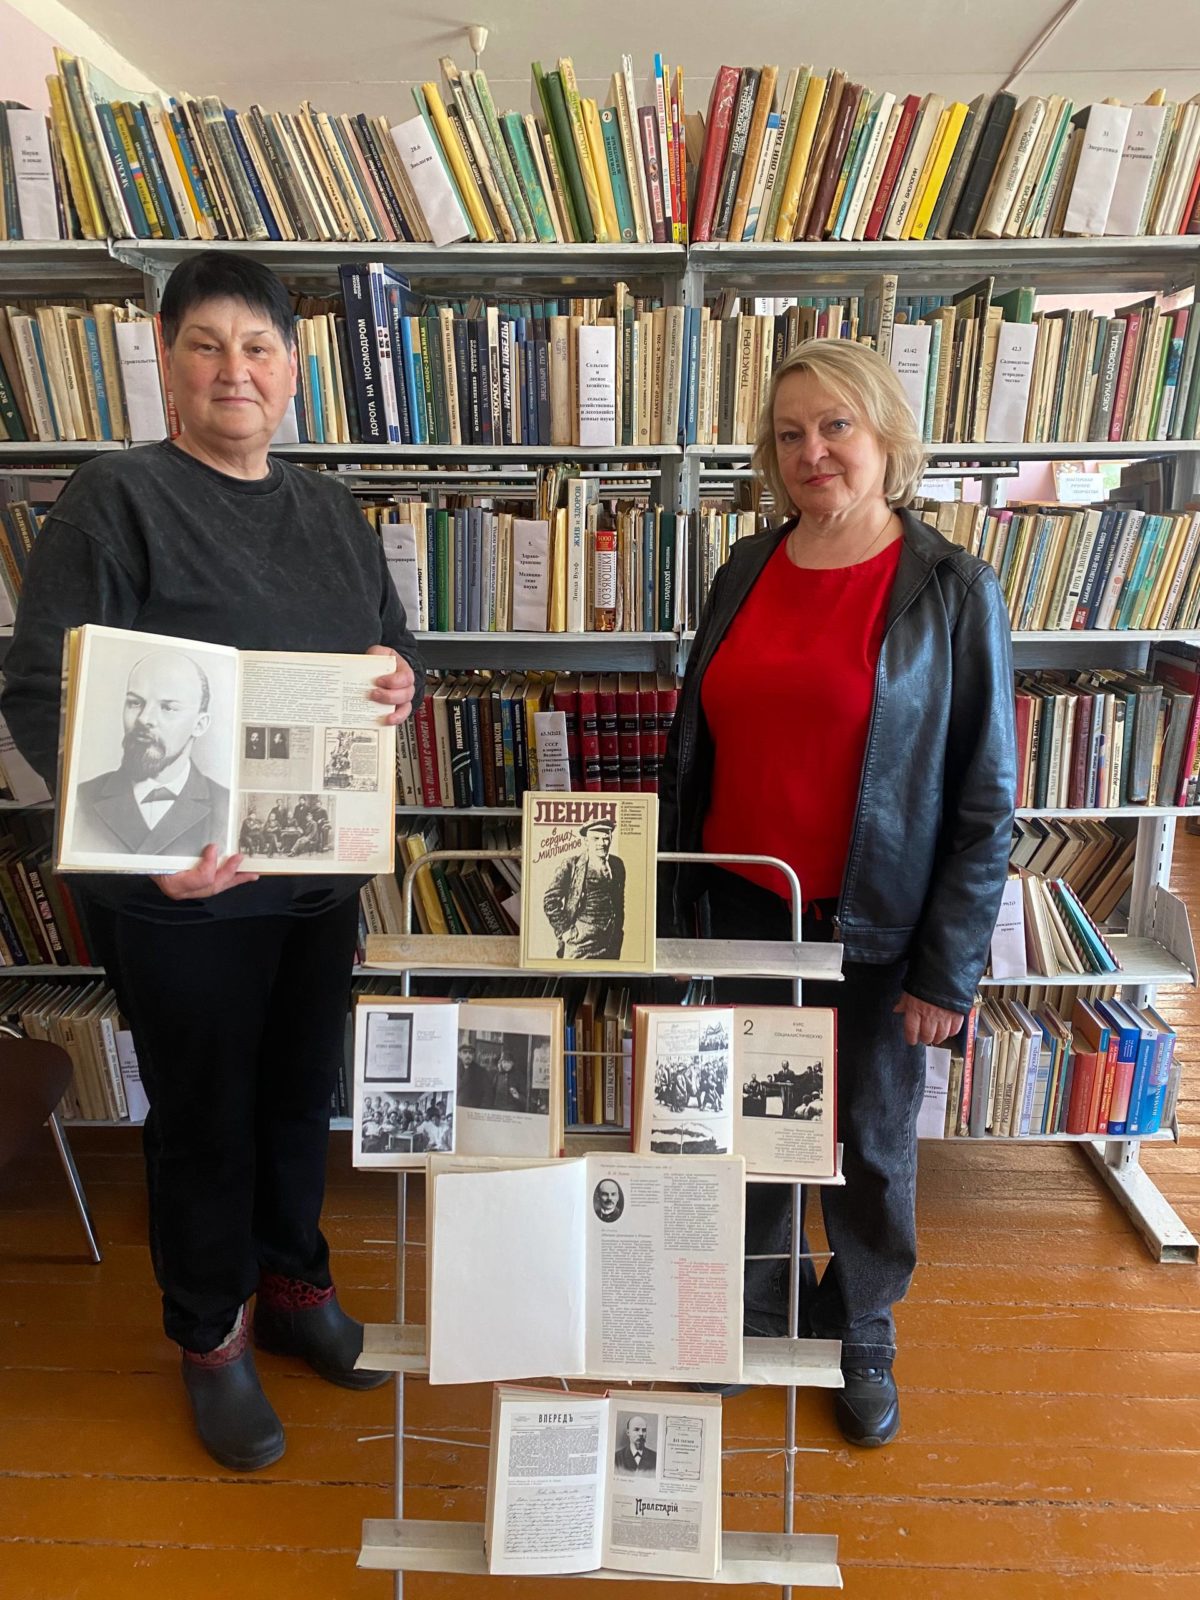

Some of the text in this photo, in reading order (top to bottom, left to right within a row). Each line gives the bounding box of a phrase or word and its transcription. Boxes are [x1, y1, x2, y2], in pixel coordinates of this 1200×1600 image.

[730, 85, 750, 153] МИР ЖИВОТНЫХ
[113, 153, 129, 188] МОСКВА
[605, 136, 616, 175] ДОМАШНИЕ
[611, 135, 620, 174] ЖИВОТНЫЕ
[766, 173, 774, 190] КТО
[770, 150, 779, 170] ОНИ
[775, 118, 786, 146] ТАКИЕ
[471, 163, 483, 184] КНИГА
[895, 167, 918, 226] ОСНОВЫ БИОЛОГИИ
[1013, 185, 1030, 223] БИОЛОГИЯ
[92, 352, 100, 365] КТО
[501, 322, 509, 365] ПОБЕДЫ
[741, 329, 751, 389] ТРАКТОРЫ
[776, 333, 784, 362] ТРАКТОР
[96, 383, 104, 397] ДЛЯ
[358, 318, 379, 436] ДОРОГА НА КОСМОДРОМ
[981, 362, 994, 410] БОТАНИКА
[1102, 335, 1119, 412] АЗБУКА САДОВОДА
[1097, 532, 1107, 551] СОВЕТЫ
[1117, 542, 1128, 568] СУСТАВОВ
[1121, 541, 1134, 574] УКРЕПЛЕНИЯ
[1072, 575, 1082, 589] ПУТЬ
[1077, 531, 1093, 569] ДОЛГОЛЕТИЮ
[601, 553, 612, 606] ХОЗЯЮШКИ
[1082, 584, 1093, 603] ХИРУРГА
[420, 721, 430, 749] ФРОНТА
[454, 705, 464, 749] ЛИХОЛЕТЬЕ
[494, 722, 503, 766] ИСТОРИЯ РОССИИ
[424, 757, 434, 784] ПИСЬМА
[534, 801, 618, 824] ЛЕНИН
[540, 830, 576, 850] сердцах
[552, 828, 558, 836] в
[533, 838, 582, 864] миллионов
[743, 1019, 754, 1036] 2
[774, 1032, 824, 1040] СОЦИАЛИСТИЧЕСКУЮ
[606, 1055, 616, 1108] ЯНУШ КОРЧАК
[1024, 1046, 1038, 1119] Волшебный Букварь
[1002, 1083, 1013, 1123] РУССКИЙ ЯЗЫК
[538, 1413, 574, 1424] ВПЕРЕДЪ
[634, 1498, 678, 1516] Пролетарій
